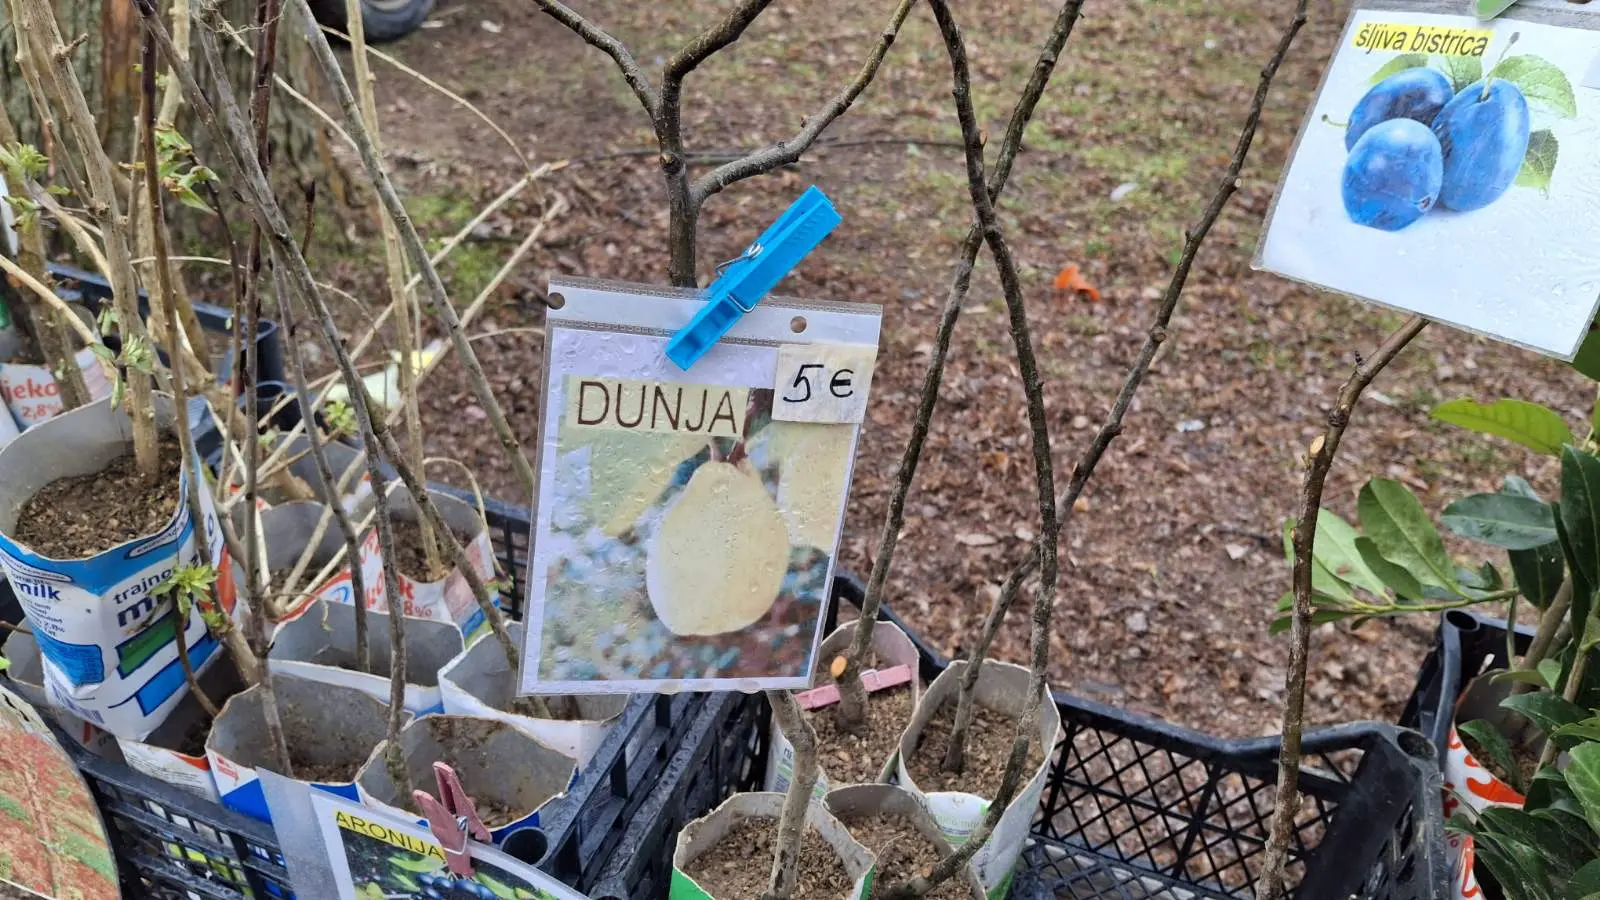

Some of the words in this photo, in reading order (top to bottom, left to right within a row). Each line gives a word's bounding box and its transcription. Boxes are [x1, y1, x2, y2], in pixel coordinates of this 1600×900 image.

[1355, 24, 1408, 54] šljiva
[1410, 27, 1488, 57] bistrica
[577, 380, 738, 434] DUNJA
[14, 581, 62, 602] milk
[336, 811, 447, 865] ARONIJA
